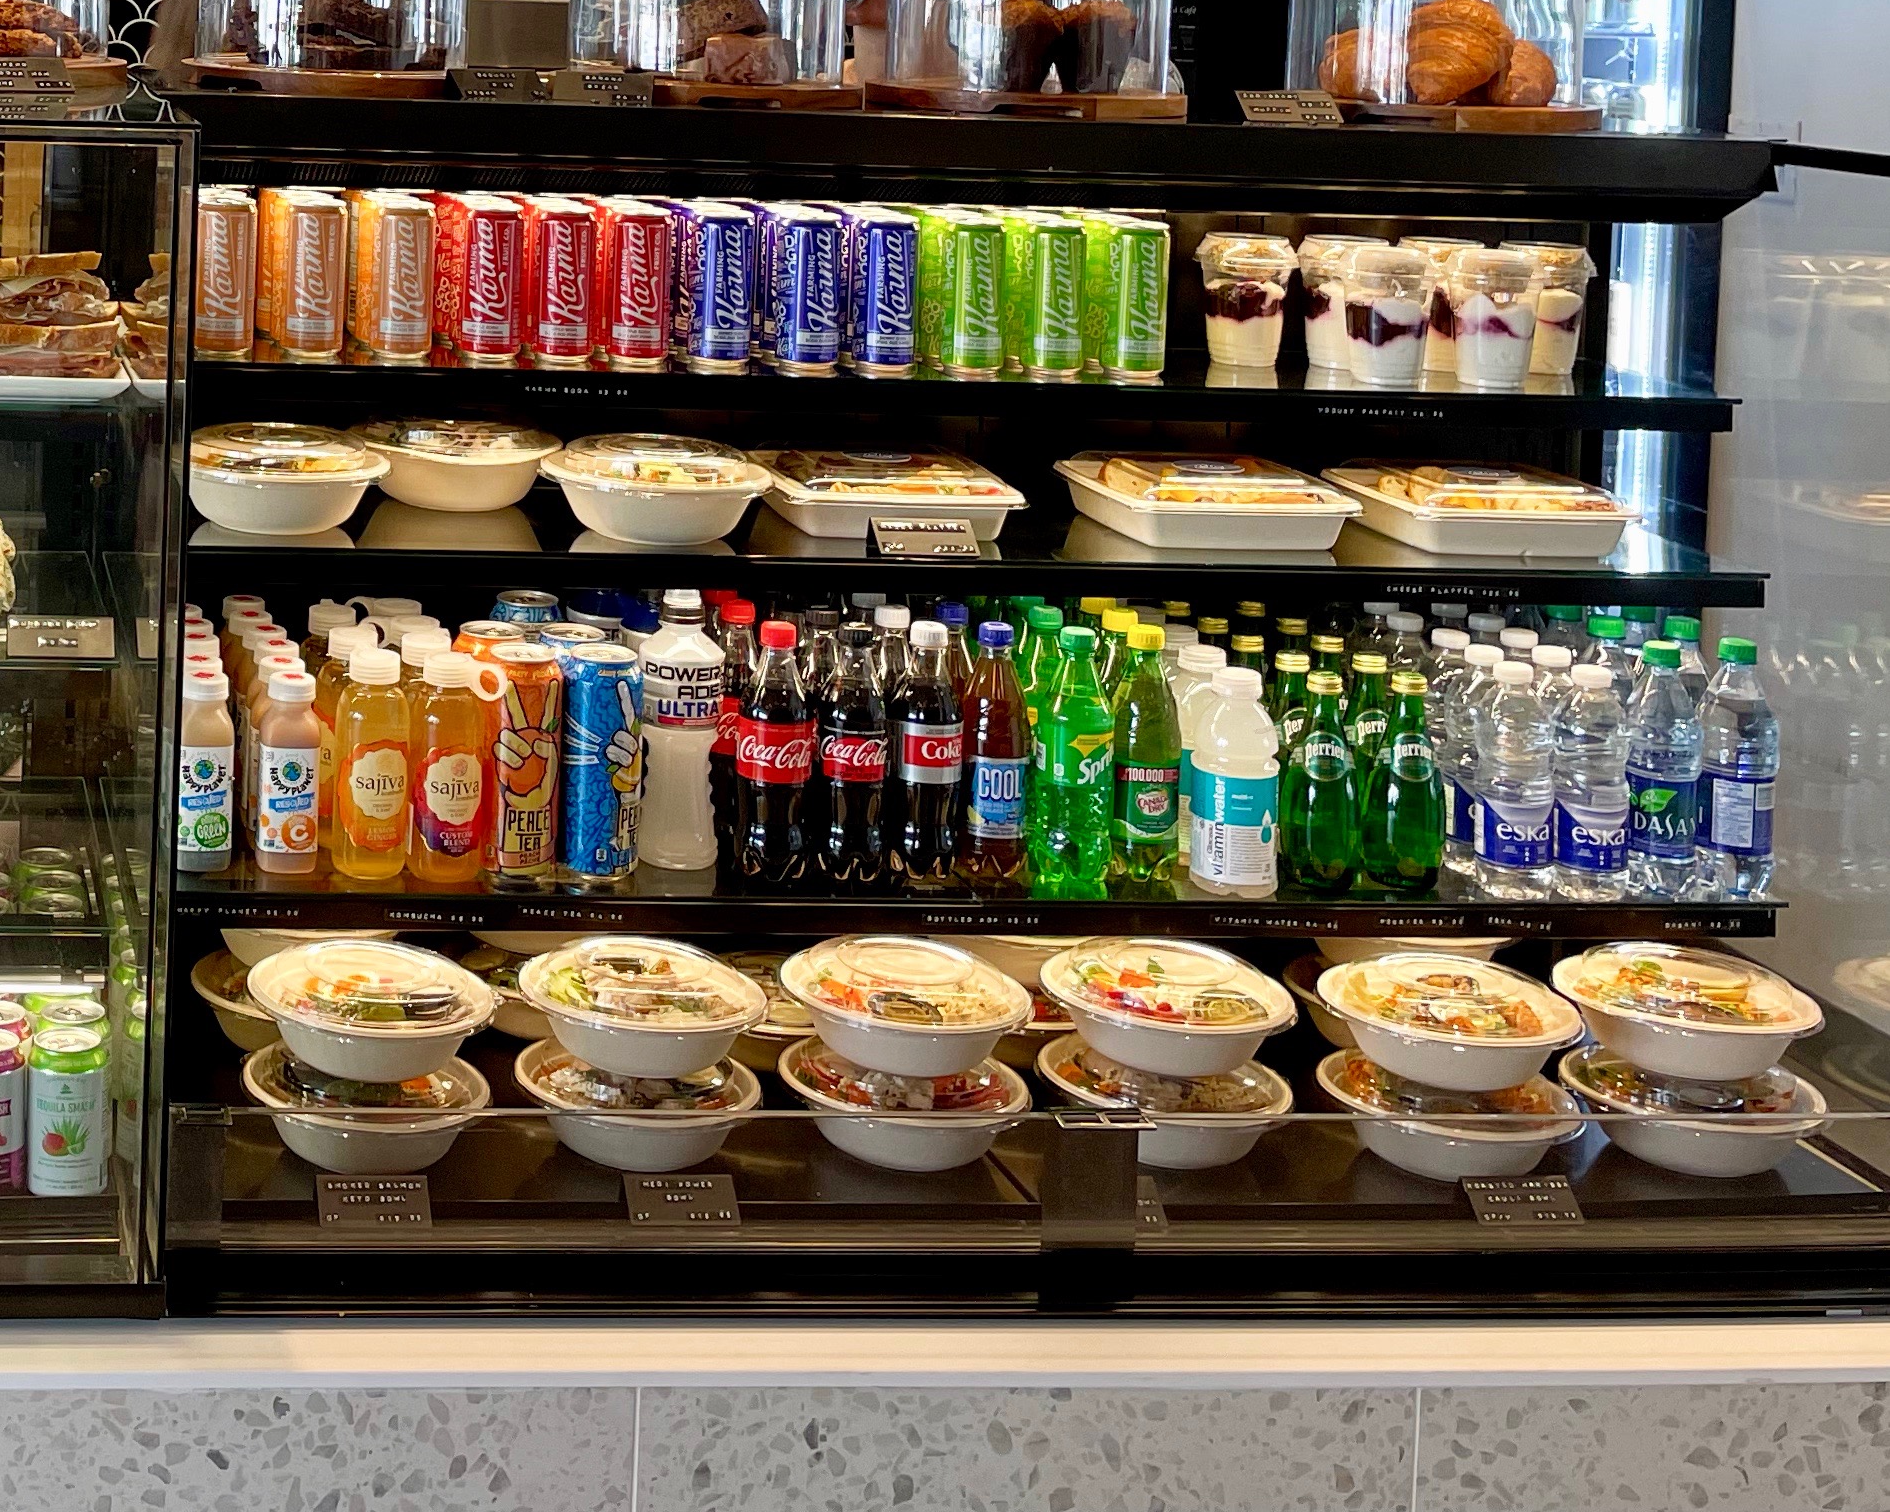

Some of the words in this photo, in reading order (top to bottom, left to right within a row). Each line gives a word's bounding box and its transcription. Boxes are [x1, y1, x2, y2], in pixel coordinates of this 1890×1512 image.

[469, 243, 478, 286] FARMING
[469, 217, 507, 322] Karma
[547, 220, 585, 324] Karma
[715, 250, 724, 294] FARMING
[715, 224, 750, 329] Karma
[807, 228, 839, 332] Karma
[965, 233, 999, 336] Karma
[645, 661, 721, 681] POWER
[659, 699, 719, 717] ULTRA
[677, 685, 720, 700] ADE
[740, 735, 811, 769] Coca-Cola
[821, 735, 888, 767] Coca-Cola
[1077, 741, 1114, 784] Spri
[978, 767, 1022, 800] COOL
[508, 809, 551, 832] PEACE
[1212, 776, 1226, 876] vitaminwater
[1496, 822, 1550, 842] eska
[1634, 810, 1697, 840] DASA
[516, 834, 541, 852] TEA
